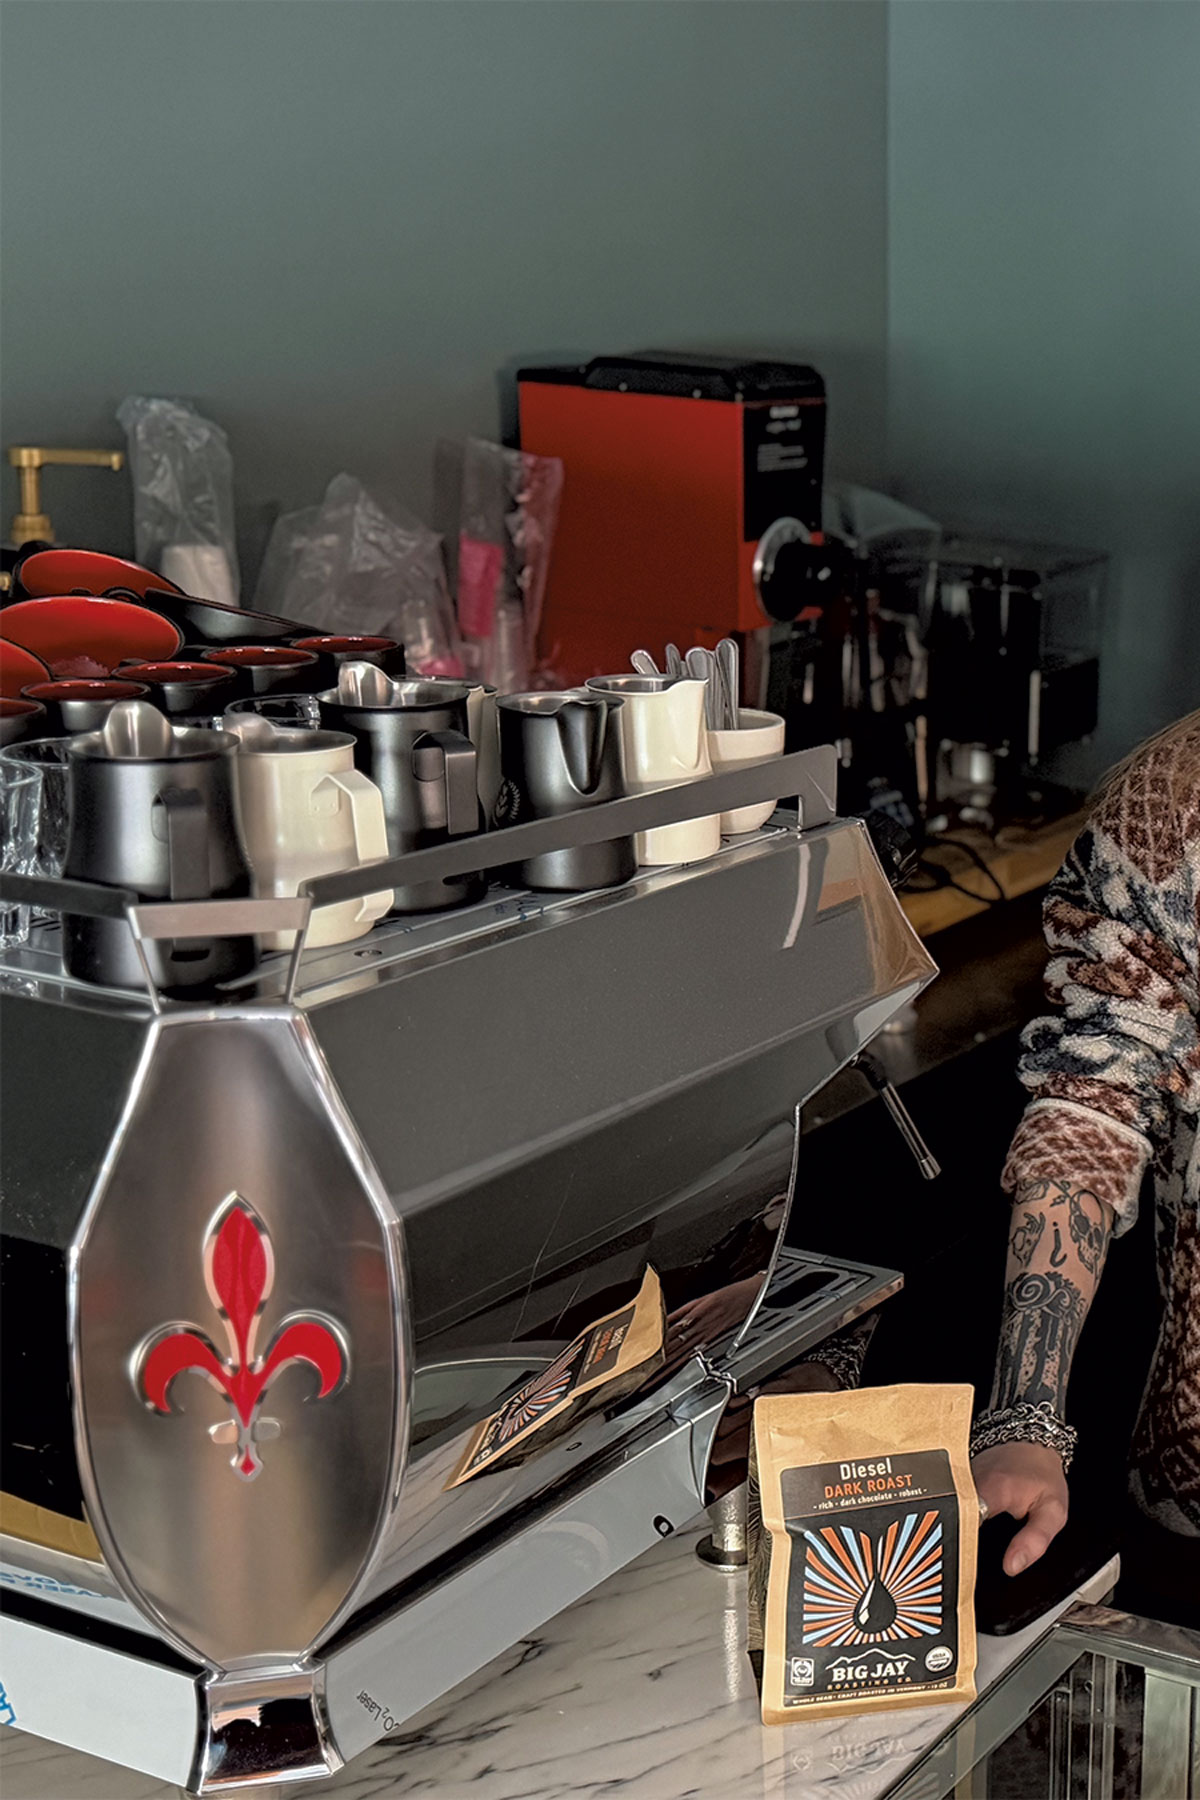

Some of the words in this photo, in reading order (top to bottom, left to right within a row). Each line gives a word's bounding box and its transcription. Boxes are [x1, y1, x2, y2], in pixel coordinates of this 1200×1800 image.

[840, 1457, 892, 1480] Diesel
[824, 1481, 863, 1499] DARK
[867, 1474, 912, 1492] ROAST
[818, 1501, 834, 1510] rich
[840, 1497, 856, 1507] dark
[858, 1491, 893, 1504] chocolate
[832, 1665, 868, 1683] BIG
[870, 1660, 910, 1678] JAY
[827, 1678, 889, 1691] ROASTING
